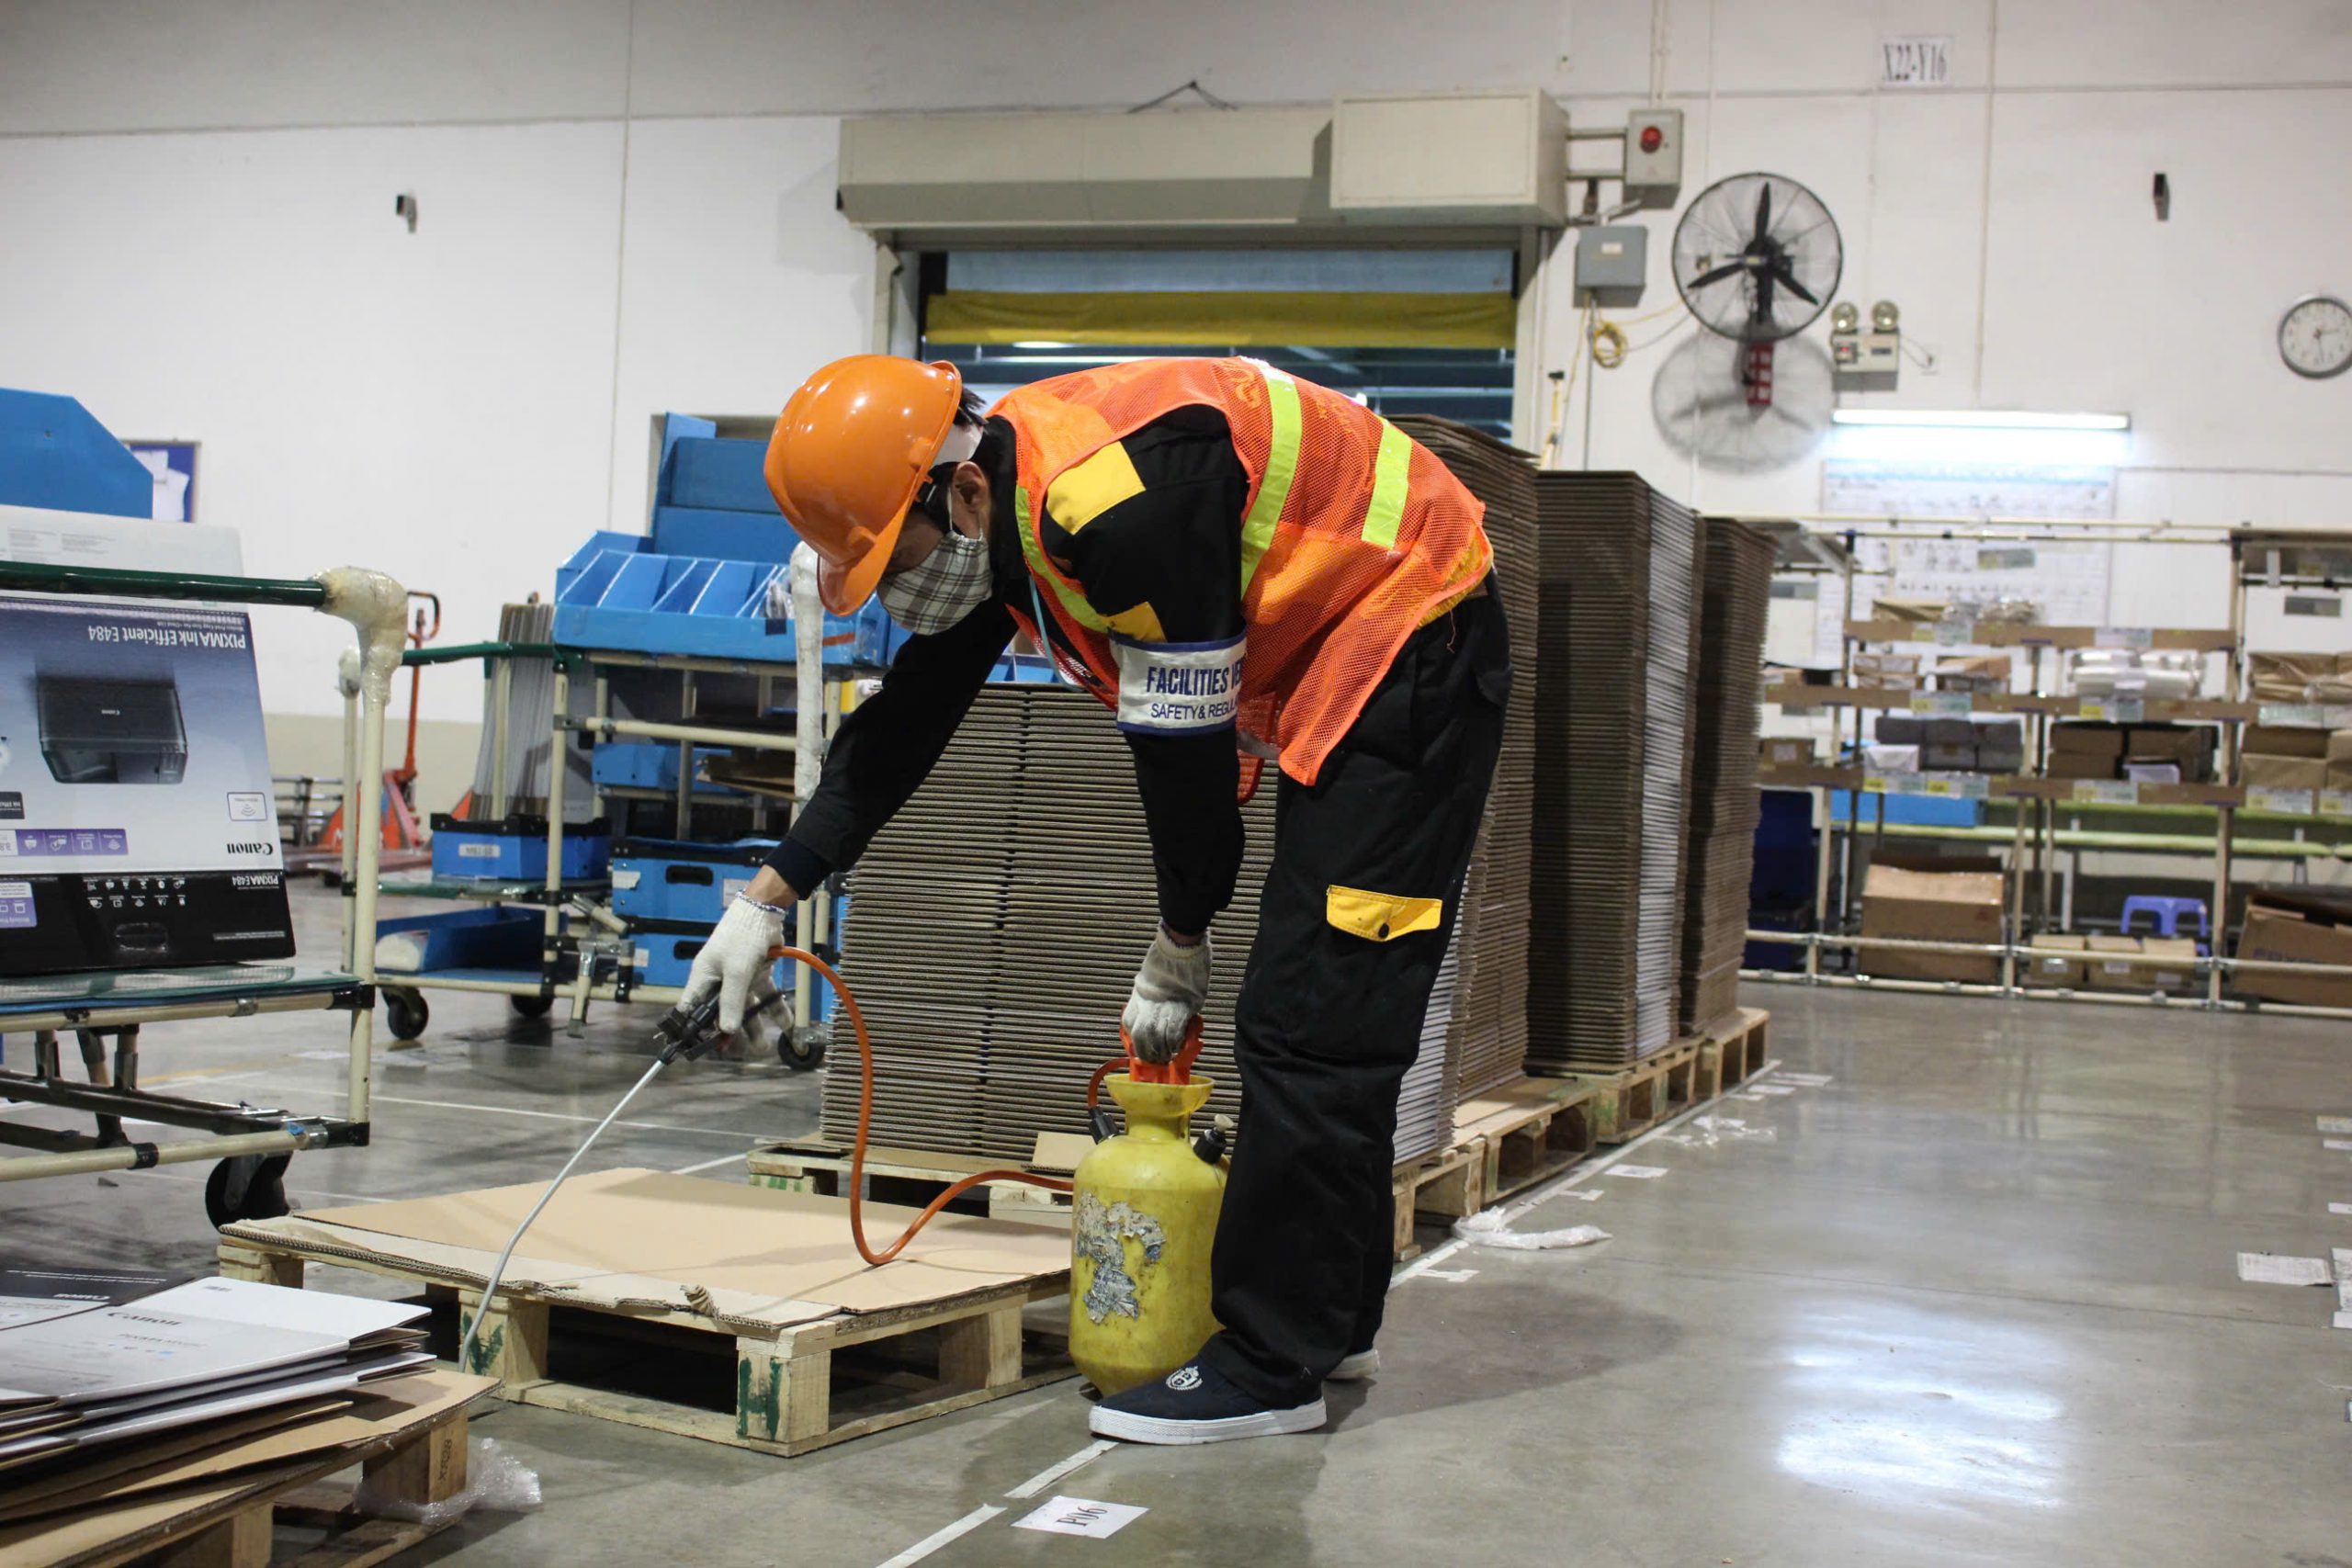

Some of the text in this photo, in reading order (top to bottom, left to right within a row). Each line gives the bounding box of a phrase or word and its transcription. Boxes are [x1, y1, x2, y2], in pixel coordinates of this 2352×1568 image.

[88, 625, 246, 649] PIXMA Ink Efficient E484
[1146, 666, 1228, 696] FACILITIES
[1151, 703, 1197, 720] SAFETY
[226, 842, 274, 856] Canon
[232, 874, 278, 886] PIXMA E484
[107, 1312, 182, 1326] Canon
[1055, 1506, 1108, 1527] P06
